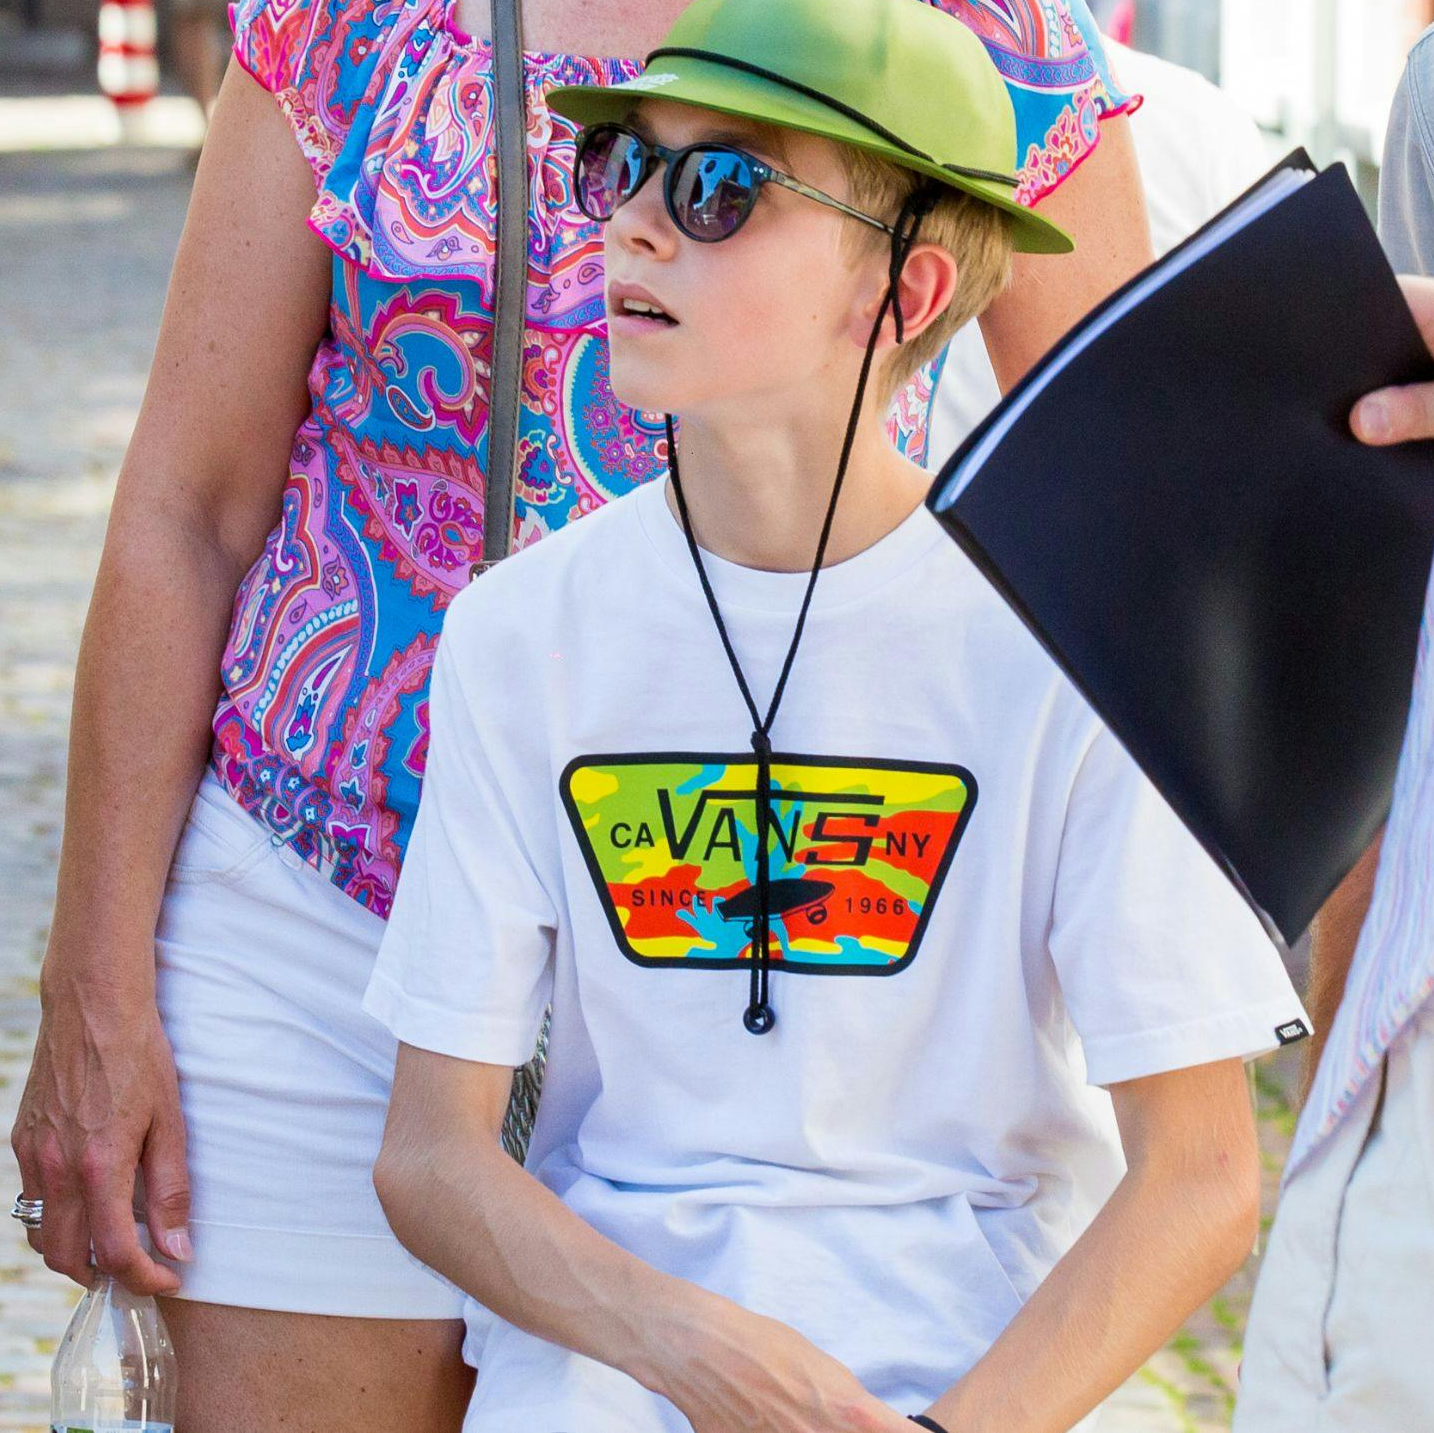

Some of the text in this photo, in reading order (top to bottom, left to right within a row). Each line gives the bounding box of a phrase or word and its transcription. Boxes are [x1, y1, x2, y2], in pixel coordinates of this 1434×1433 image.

[610, 788, 931, 867] CA VANS NY
[631, 889, 904, 915] SINCE 1966
